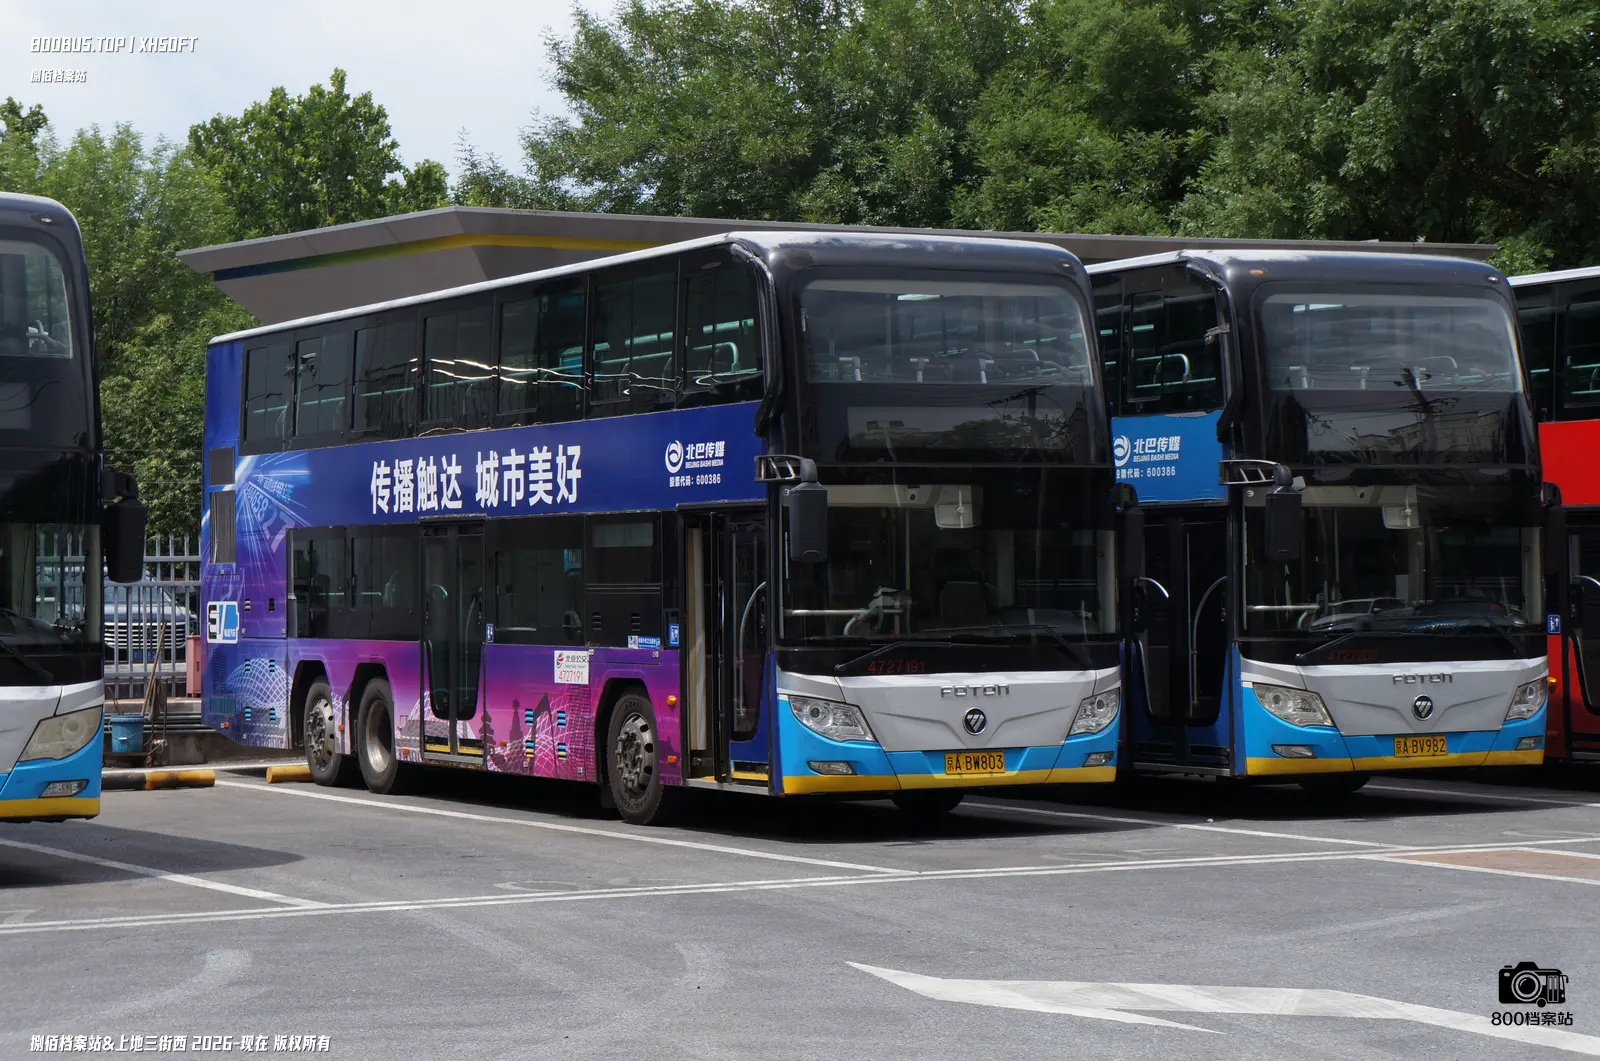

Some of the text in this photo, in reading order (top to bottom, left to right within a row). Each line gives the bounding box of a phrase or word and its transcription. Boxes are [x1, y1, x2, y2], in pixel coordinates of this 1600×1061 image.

[685, 440, 725, 460] 北巴传媒
[1133, 435, 1181, 454] 北巴传媒
[1146, 466, 1176, 477] 600386
[371, 444, 582, 514] 传播触达 城市美好
[696, 473, 721, 485] 600386
[867, 660, 926, 674] 4727191
[558, 670, 584, 682] 4727191
[940, 684, 1010, 698] FOTON
